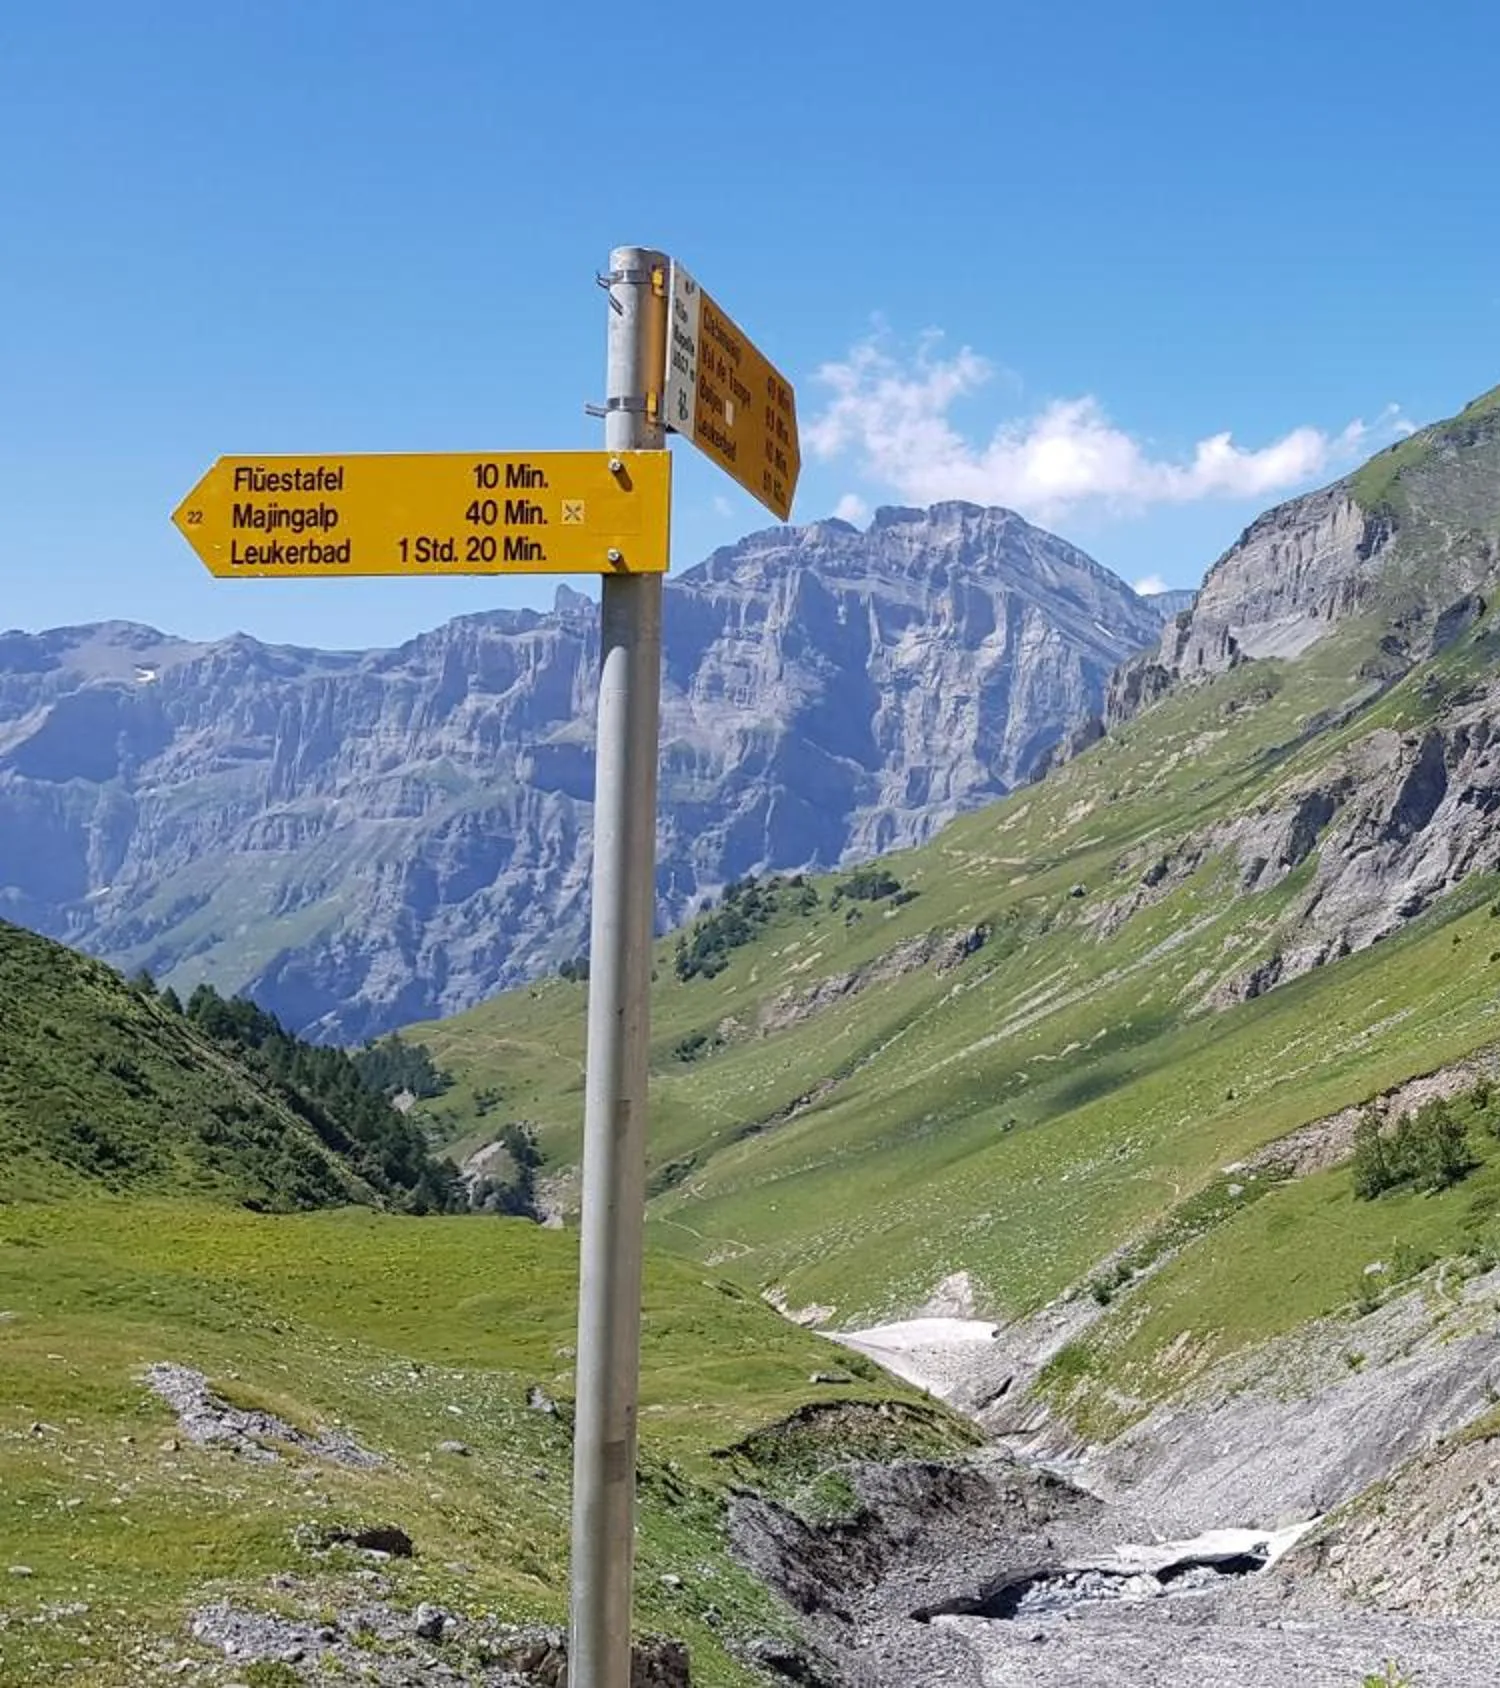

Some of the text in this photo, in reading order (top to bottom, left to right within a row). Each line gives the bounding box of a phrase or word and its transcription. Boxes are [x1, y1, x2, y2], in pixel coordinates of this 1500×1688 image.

[232, 463, 549, 493] Flüestafel 10 Min.
[187, 511, 204, 525] 22
[232, 499, 549, 534] Majingalp 40 Min.
[231, 535, 547, 565] Leukerbad 1 Std. 20 Min.
